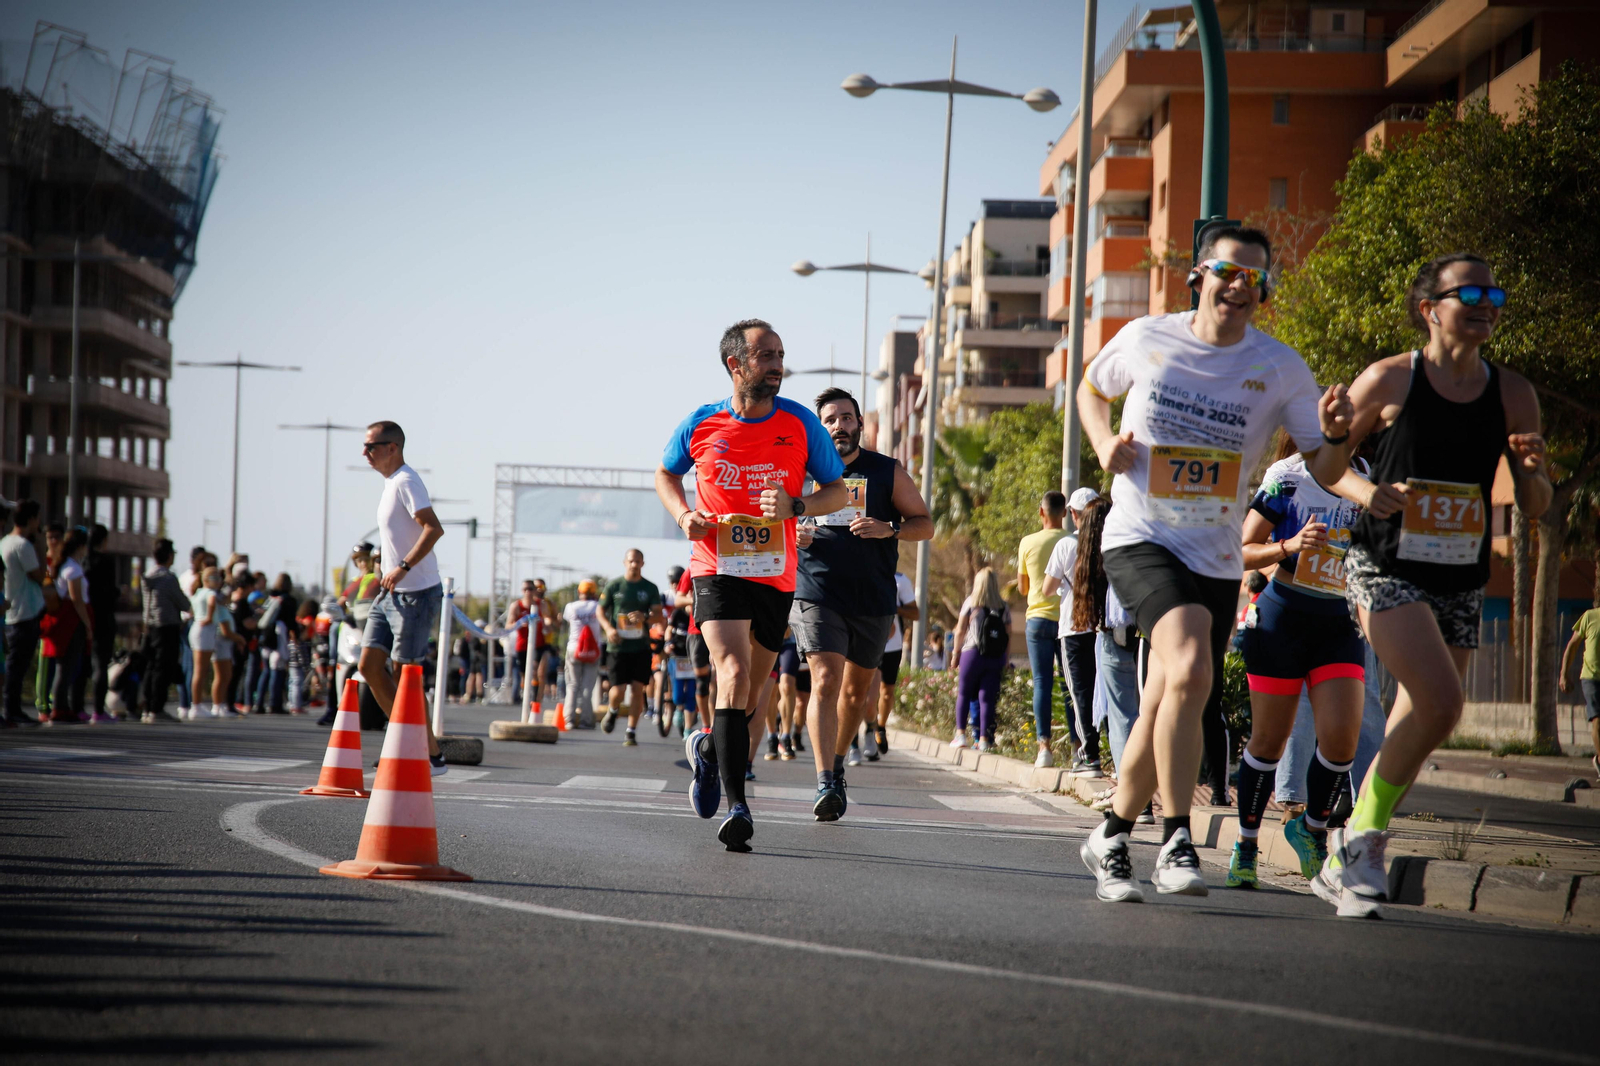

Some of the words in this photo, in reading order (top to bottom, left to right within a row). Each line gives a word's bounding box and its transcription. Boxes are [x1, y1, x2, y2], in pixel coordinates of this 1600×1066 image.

[1149, 391, 1205, 417] Almería
[1207, 409, 1247, 427] 2024
[1150, 379, 1189, 399] Medio
[1194, 393, 1250, 414] Maratón
[1146, 407, 1177, 420] RAMÓN
[1180, 415, 1200, 427] RUIZ
[1203, 424, 1245, 439] ANDÚJAR
[746, 463, 774, 472] MEDIO
[746, 469, 788, 481] MARATÓN
[1169, 459, 1220, 485] 791
[748, 478, 784, 489] ALMÍA
[1417, 495, 1481, 522] 1371
[731, 525, 771, 544] 899
